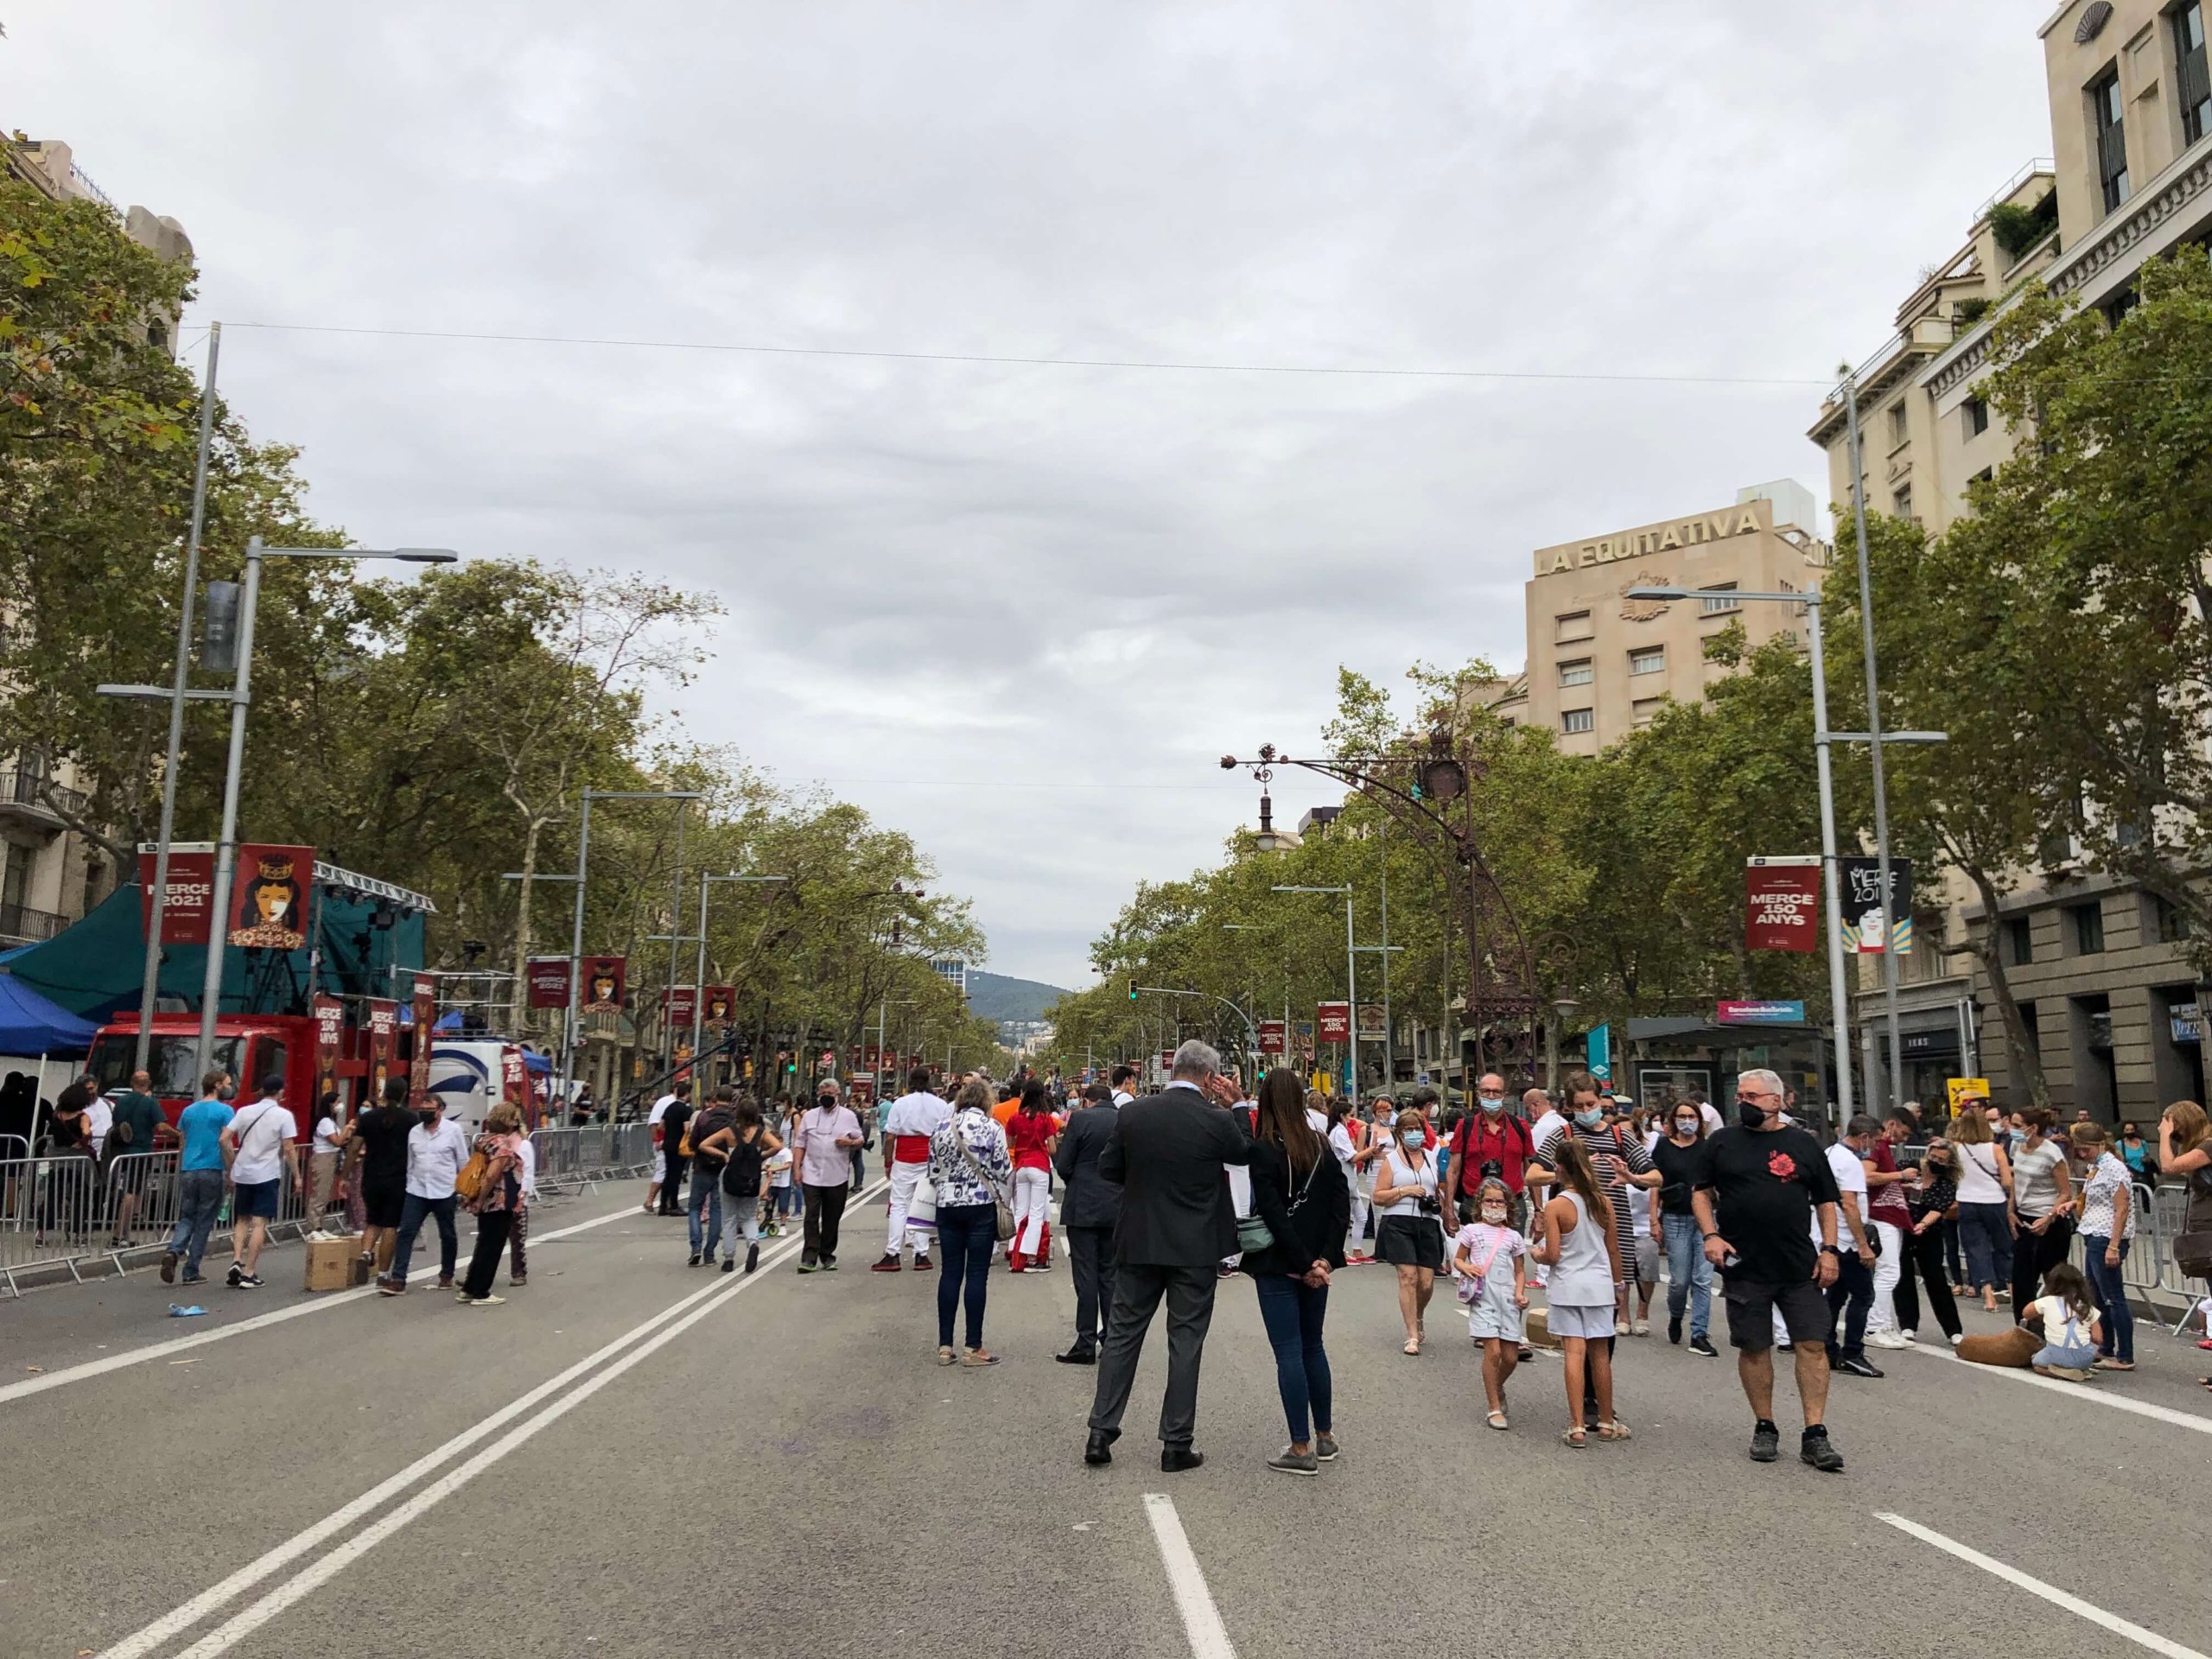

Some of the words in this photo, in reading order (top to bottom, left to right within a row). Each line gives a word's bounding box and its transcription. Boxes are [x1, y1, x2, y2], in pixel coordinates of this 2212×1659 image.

[1534, 548, 1574, 577] LA
[1578, 507, 1762, 568] EQUITATIVA
[1764, 904, 1798, 914] 150
[1755, 914, 1806, 925] ANYS
